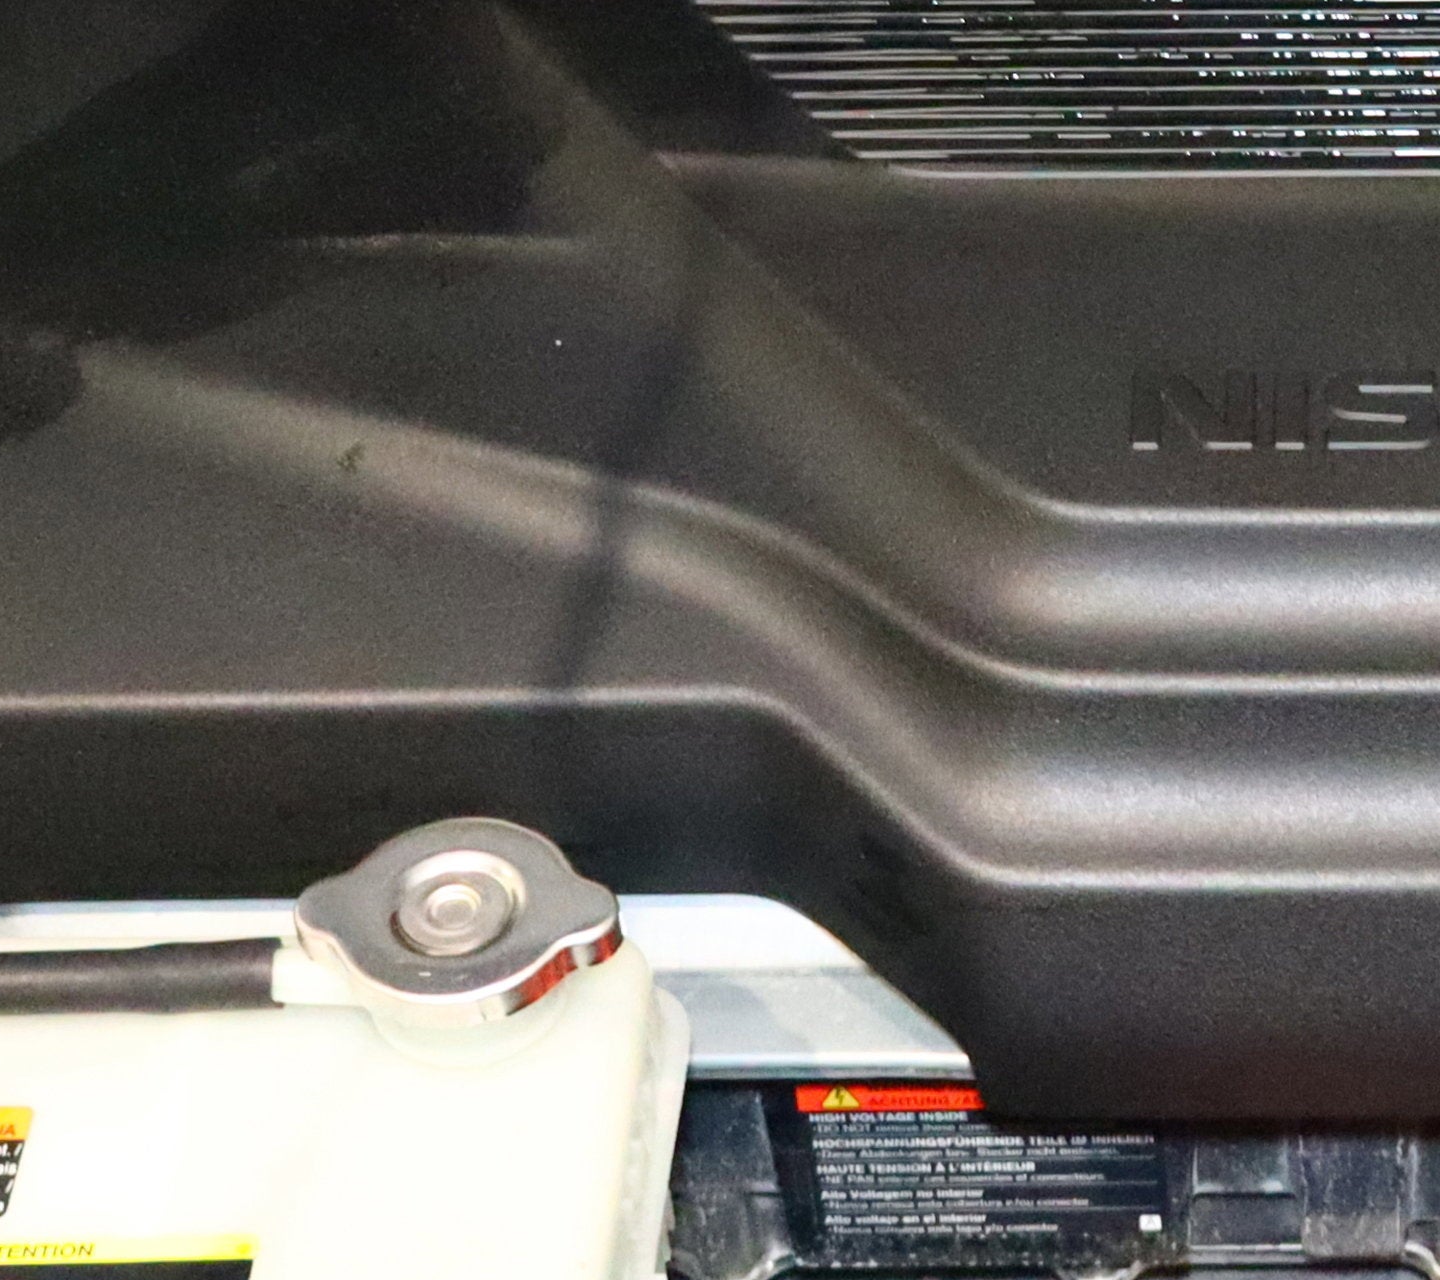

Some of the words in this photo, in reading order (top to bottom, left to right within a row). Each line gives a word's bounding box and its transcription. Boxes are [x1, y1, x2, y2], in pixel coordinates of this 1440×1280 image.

[809, 1111, 846, 1123] HIGH
[848, 1111, 916, 1123] VOLTAGE
[919, 1111, 969, 1122] INSIDE
[868, 1162, 933, 1174] TENSION
